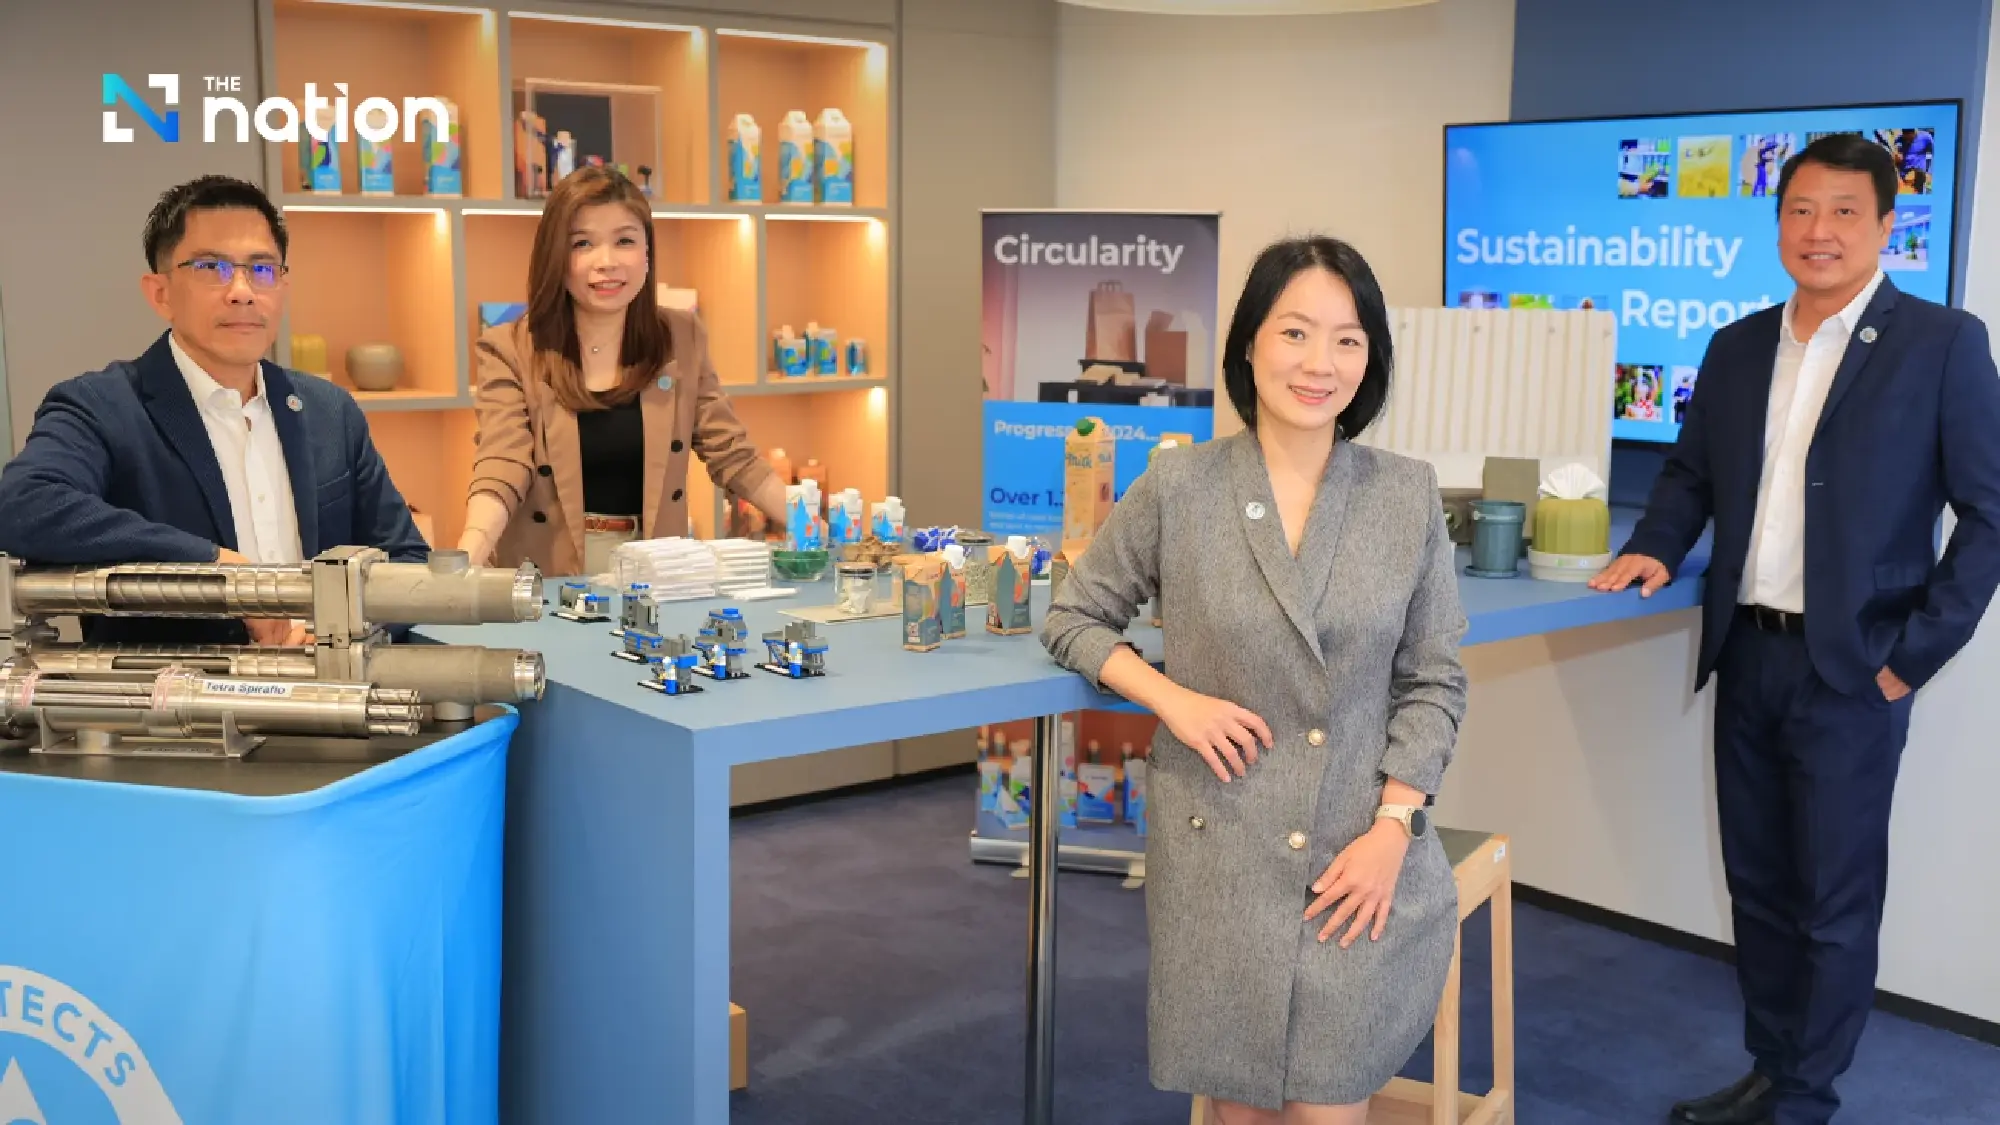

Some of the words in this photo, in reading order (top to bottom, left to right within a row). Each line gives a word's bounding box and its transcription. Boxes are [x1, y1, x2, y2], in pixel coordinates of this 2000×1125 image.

[994, 231, 1185, 275] Circularity
[1456, 224, 1744, 279] Sustainability
[989, 487, 1040, 506] Over
